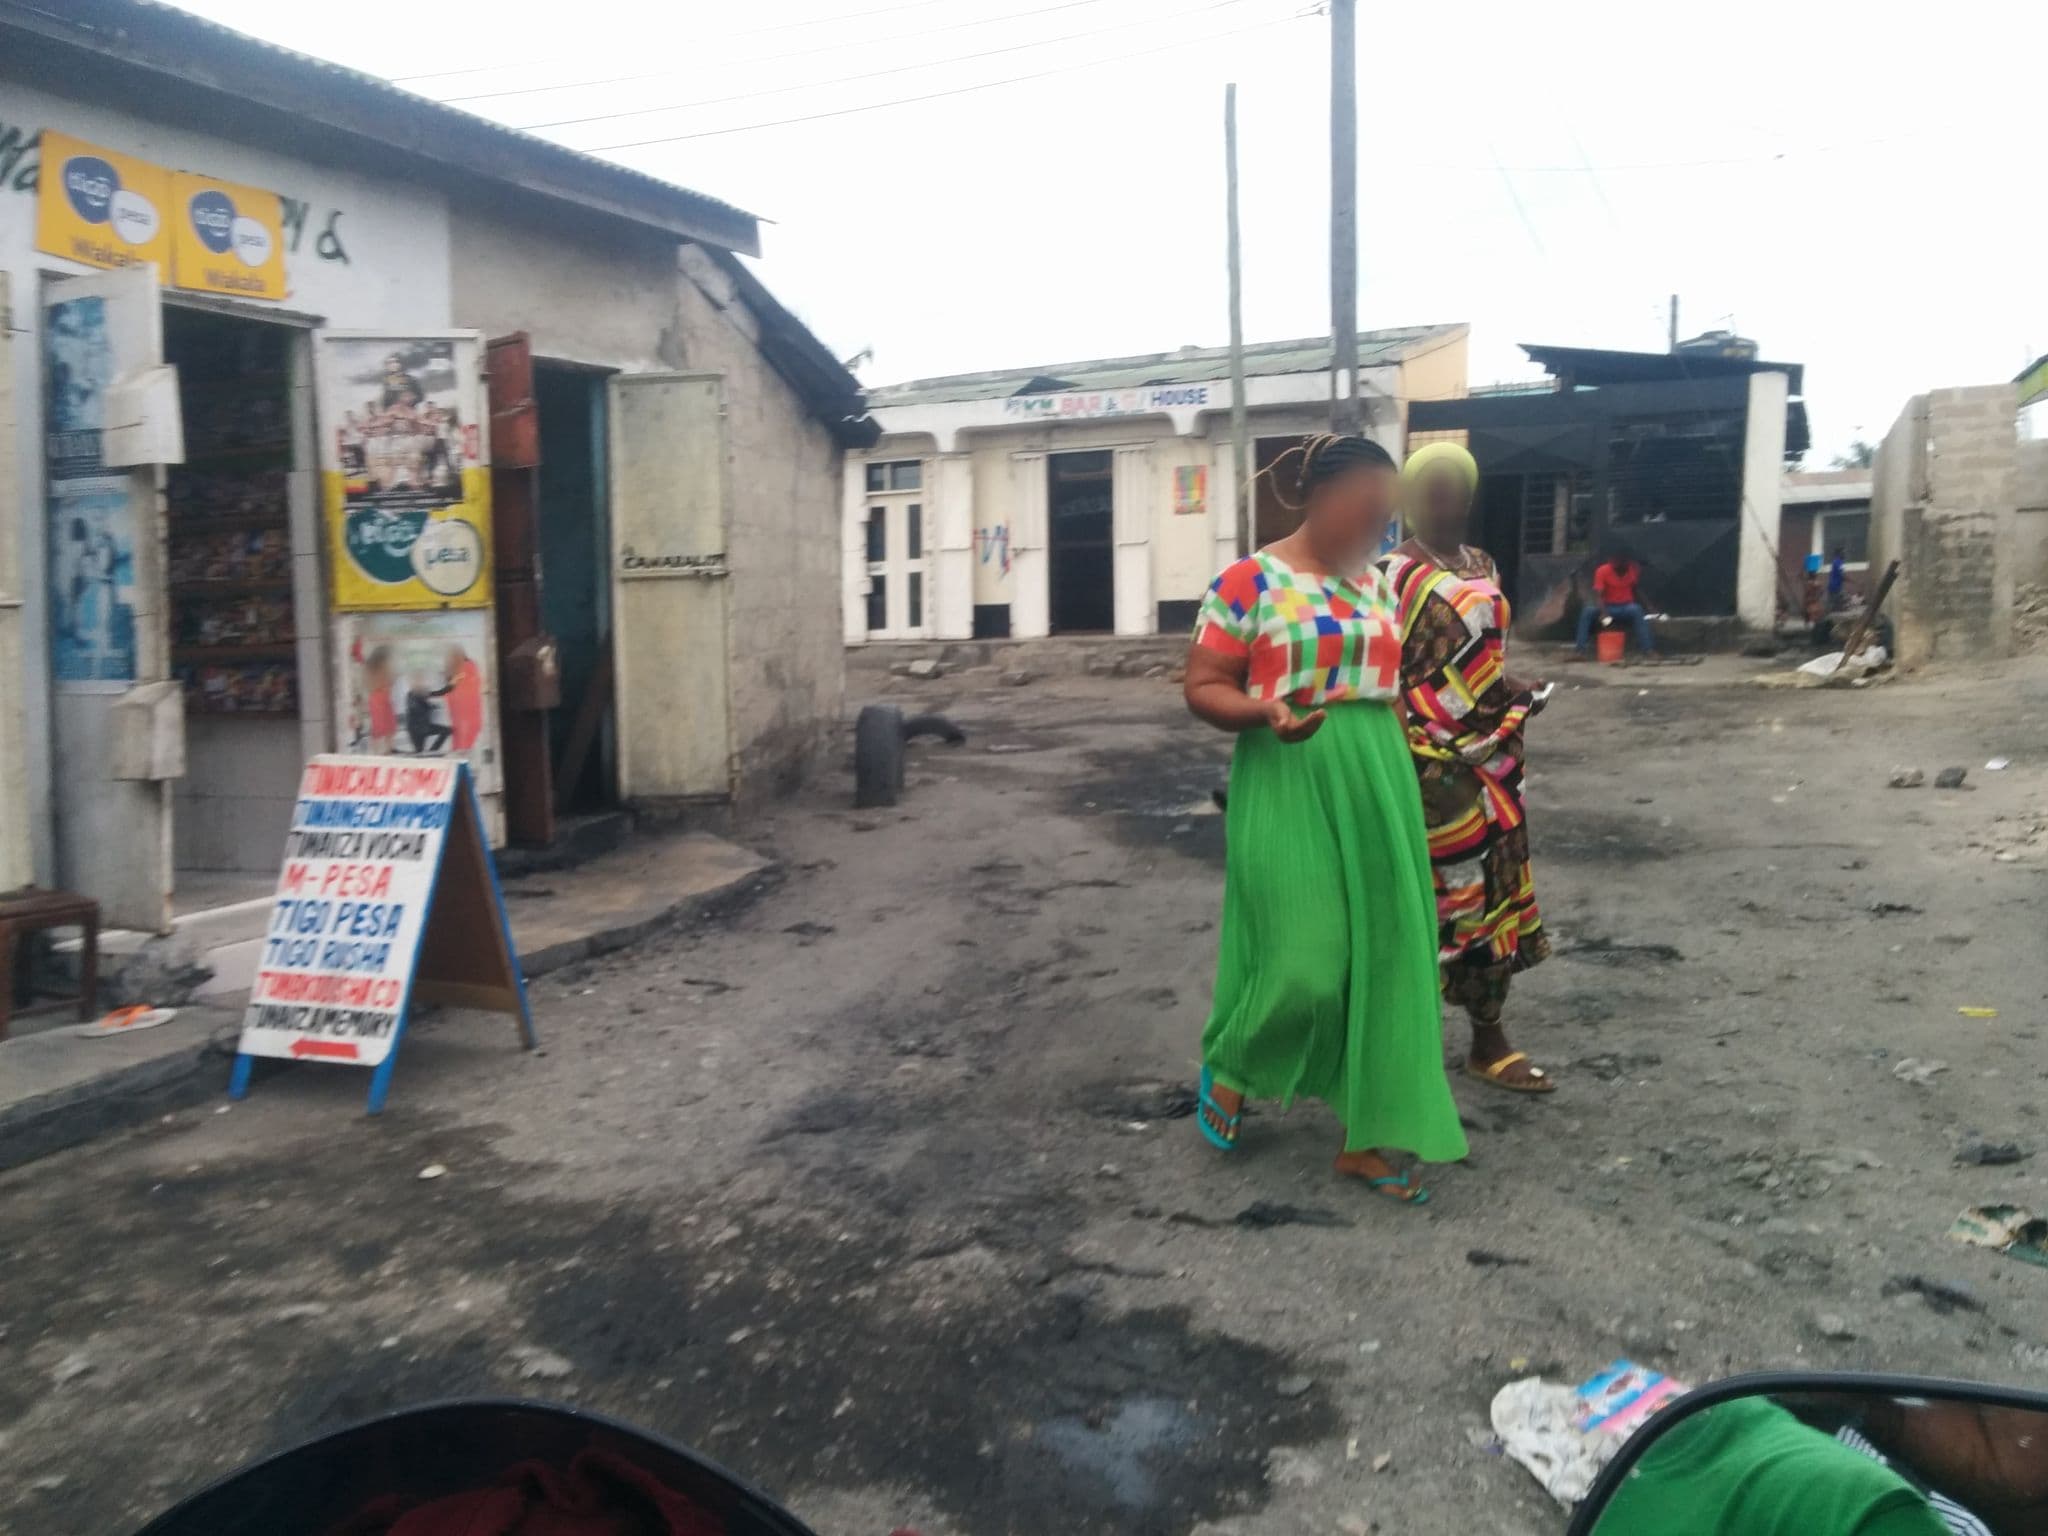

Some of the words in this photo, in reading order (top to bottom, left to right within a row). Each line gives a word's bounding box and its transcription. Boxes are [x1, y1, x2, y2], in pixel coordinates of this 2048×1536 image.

[1152, 386, 1208, 406] HOUSE
[282, 863, 394, 898] M-PESA
[274, 899, 330, 935] TIGO
[332, 902, 406, 937] PESA
[266, 937, 319, 968] TIGO
